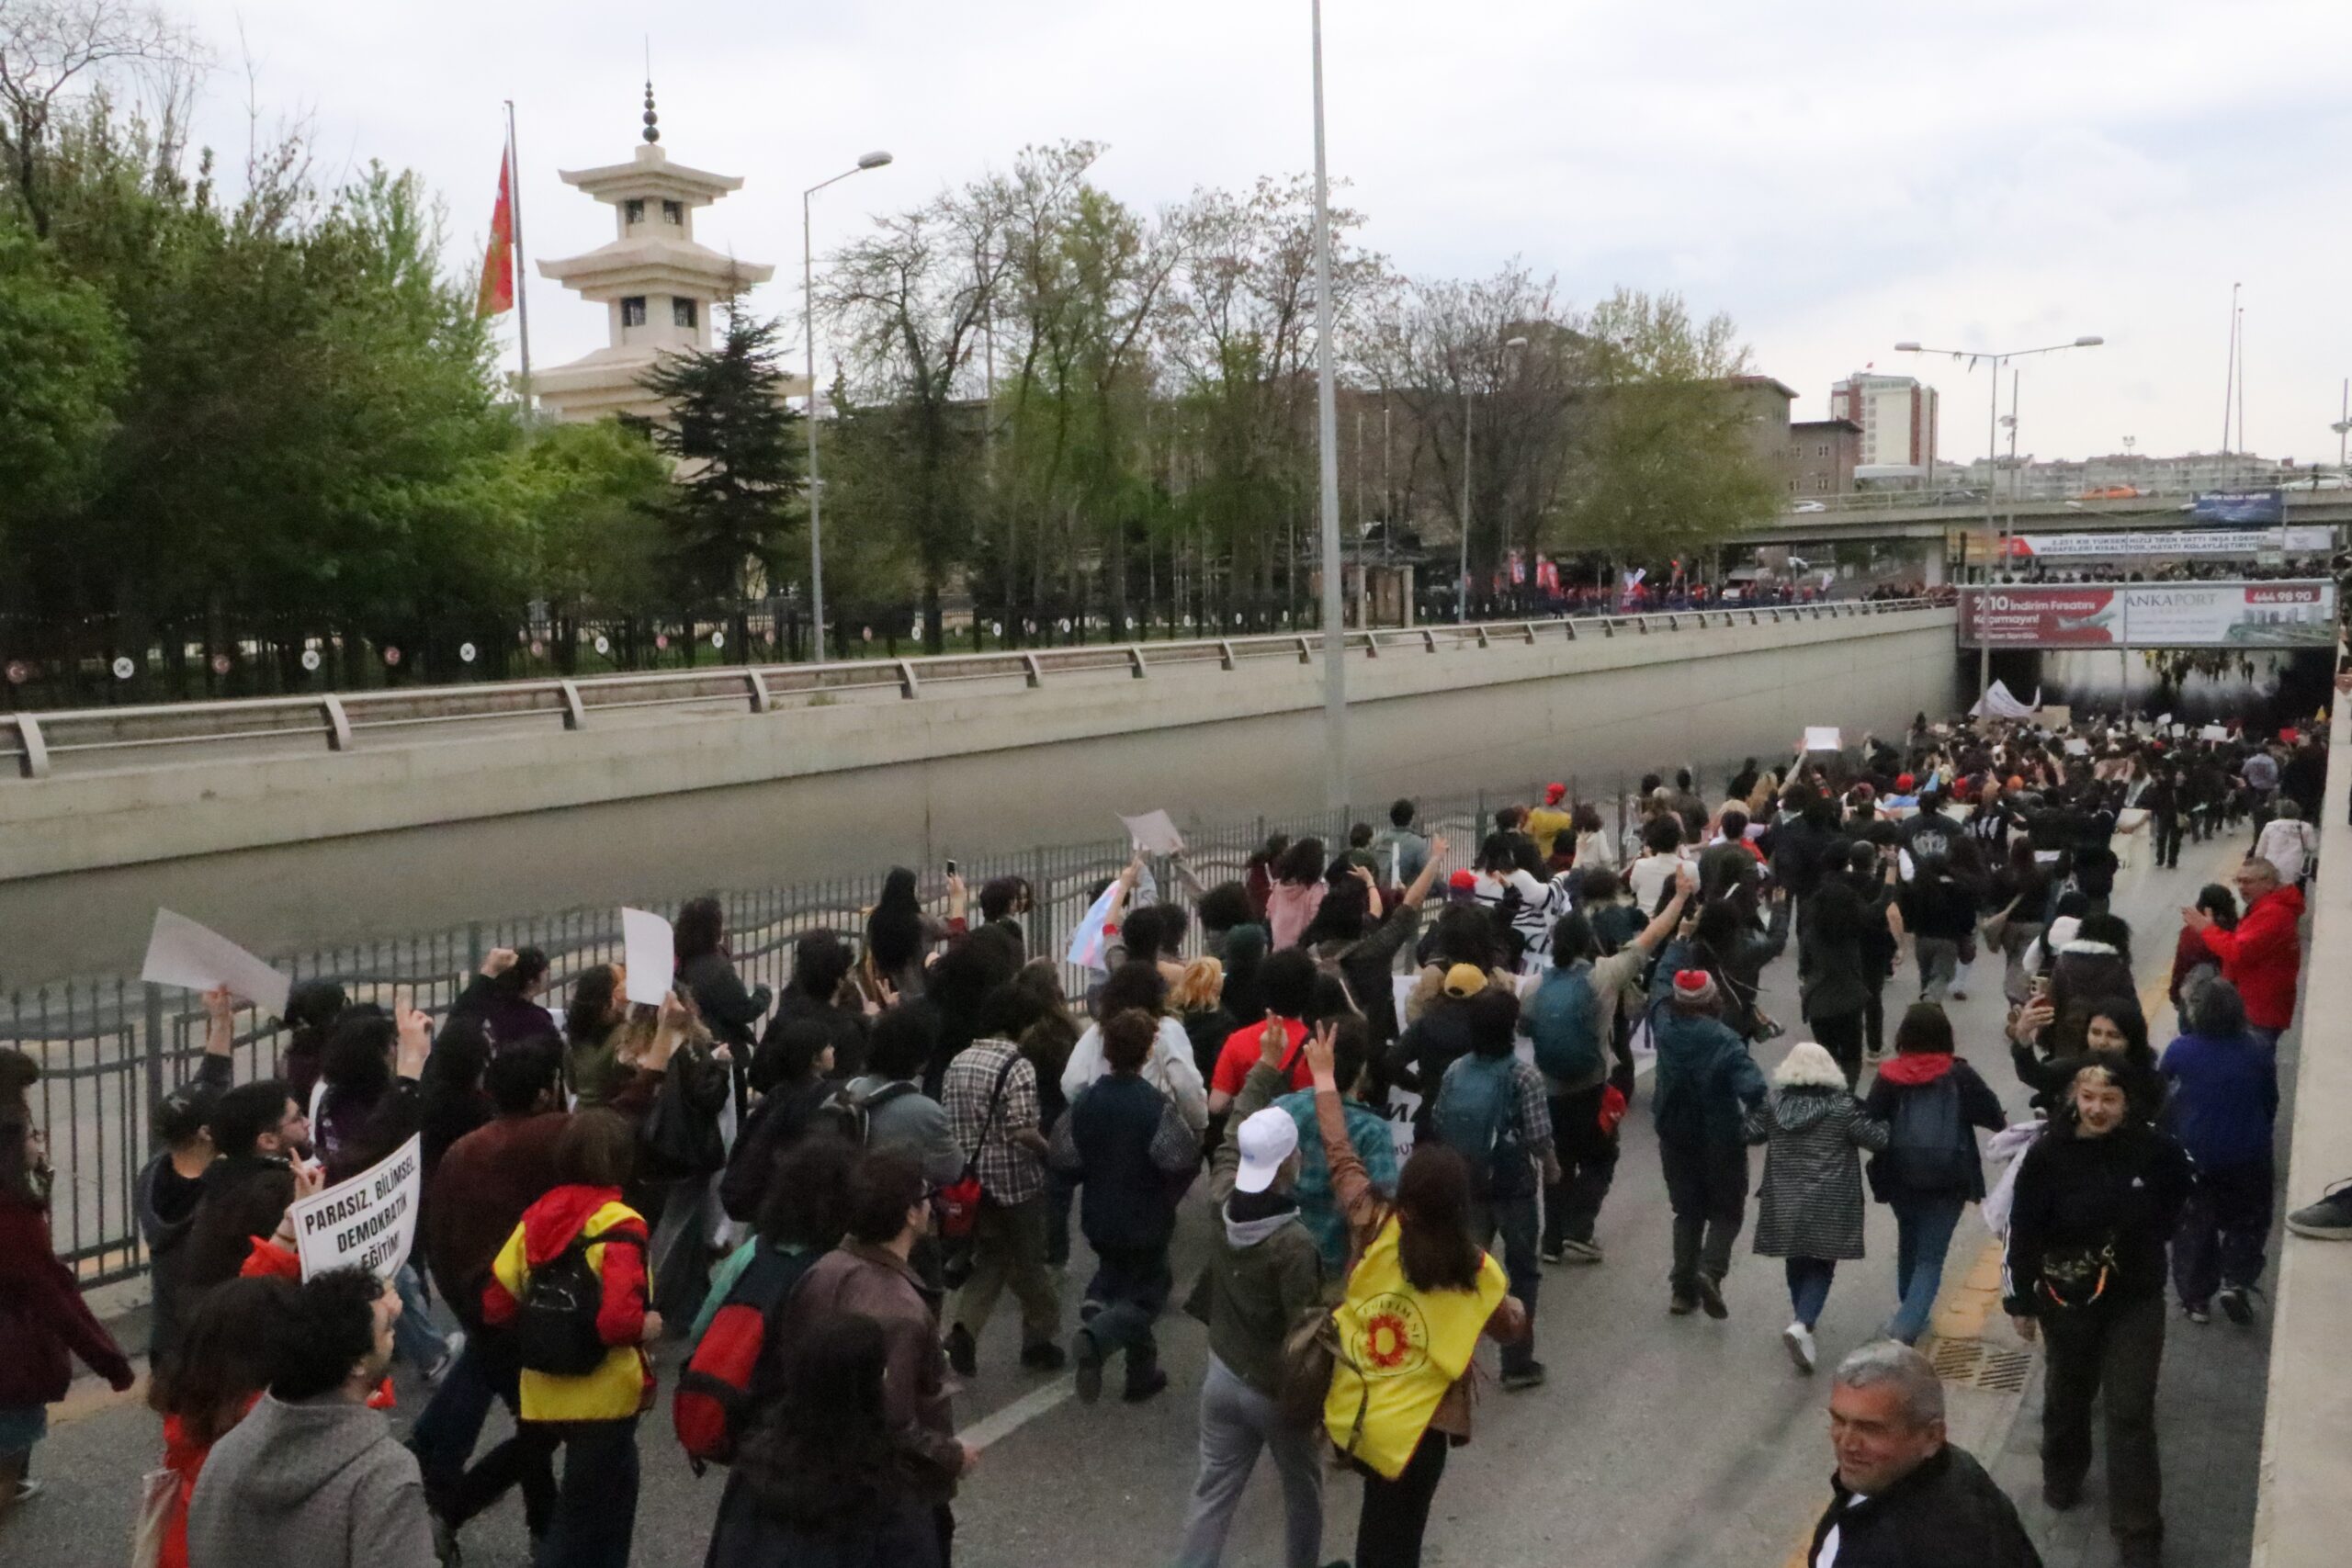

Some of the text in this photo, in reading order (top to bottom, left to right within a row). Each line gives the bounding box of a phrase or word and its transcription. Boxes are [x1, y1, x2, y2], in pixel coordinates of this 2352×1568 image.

[2125, 593, 2217, 607] ANKAPORT
[2277, 591, 2293, 602] 98
[2295, 591, 2312, 602] 90
[304, 1189, 373, 1235] PARASIZ,
[336, 1191, 407, 1254] DEMOKRATİK
